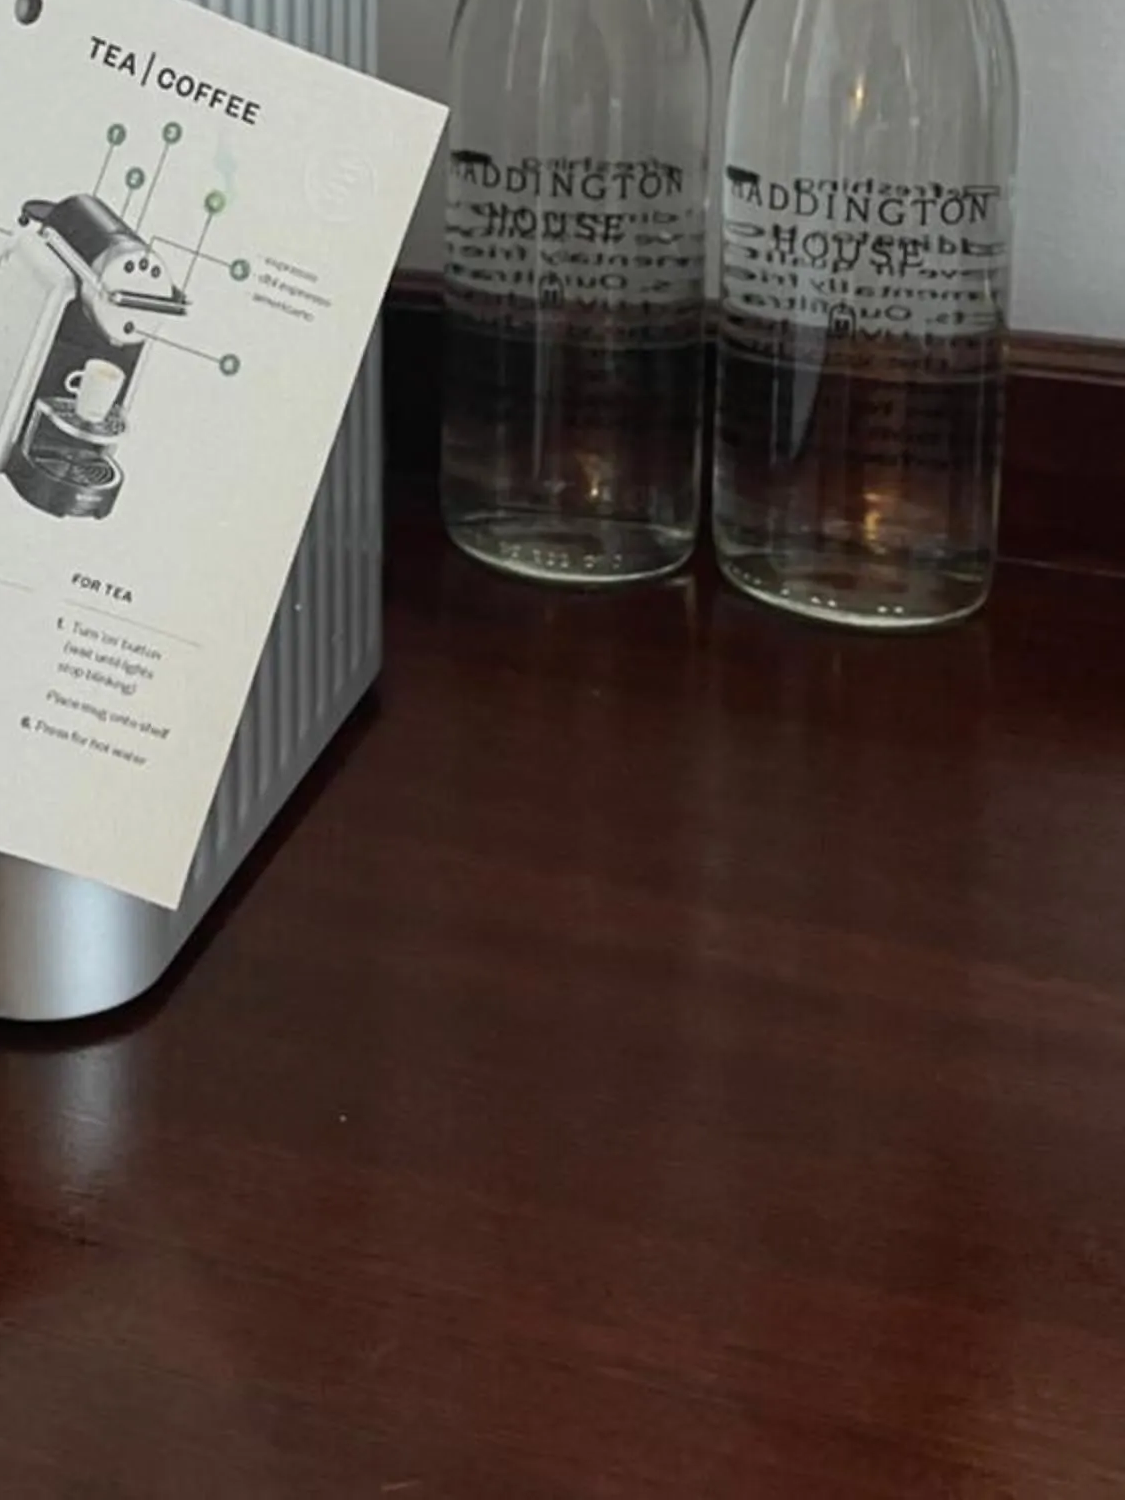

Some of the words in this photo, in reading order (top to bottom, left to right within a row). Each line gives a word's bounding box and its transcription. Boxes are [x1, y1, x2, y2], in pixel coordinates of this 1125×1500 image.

[88, 36, 136, 75] TEA
[157, 67, 261, 125] COFFEE
[486, 202, 625, 242] HOUSE
[772, 223, 924, 268] HOUSE
[71, 573, 101, 592] FOR
[106, 584, 132, 603] TEA
